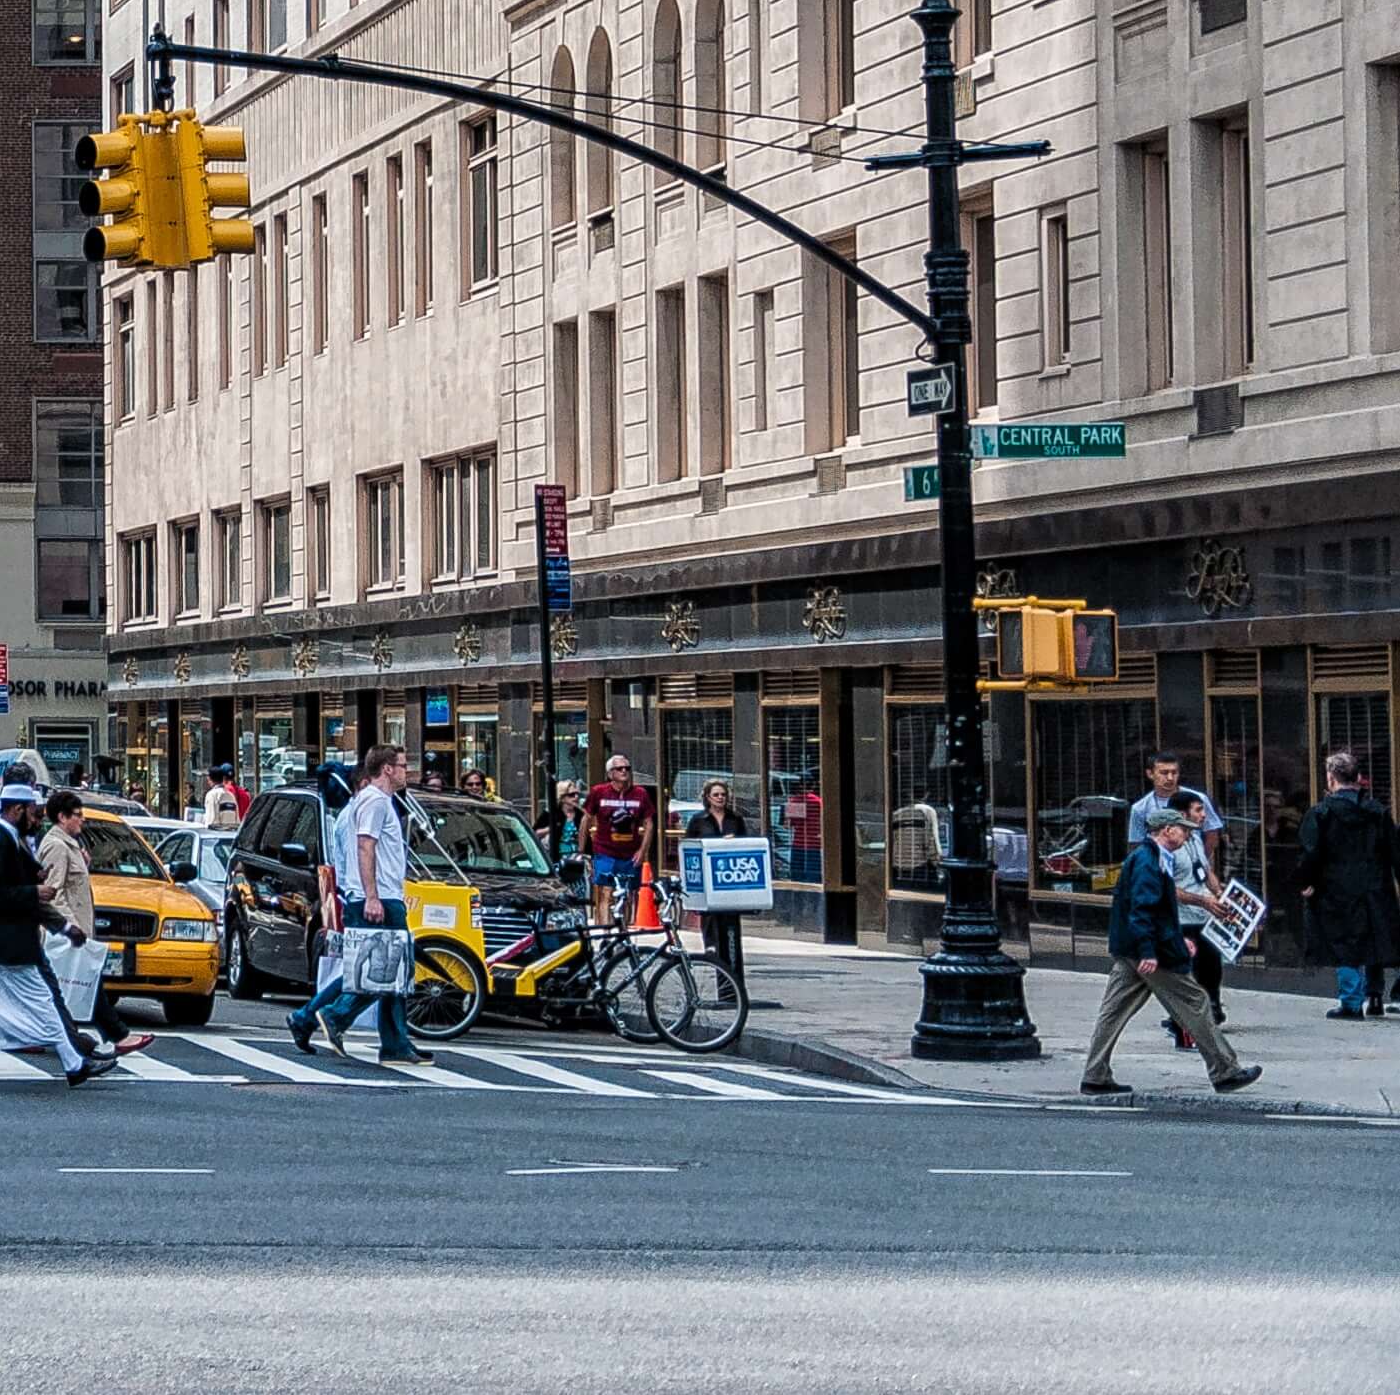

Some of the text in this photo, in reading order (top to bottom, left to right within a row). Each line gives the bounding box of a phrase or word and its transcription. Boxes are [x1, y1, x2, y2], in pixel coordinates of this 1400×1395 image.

[913, 380, 948, 403] ONE WAY
[999, 426, 1123, 446] CENTRAL PARK
[1043, 445, 1081, 456] SOUTH
[922, 473, 932, 495] 6
[729, 857, 759, 870] USA
[715, 869, 761, 884] TODAY
